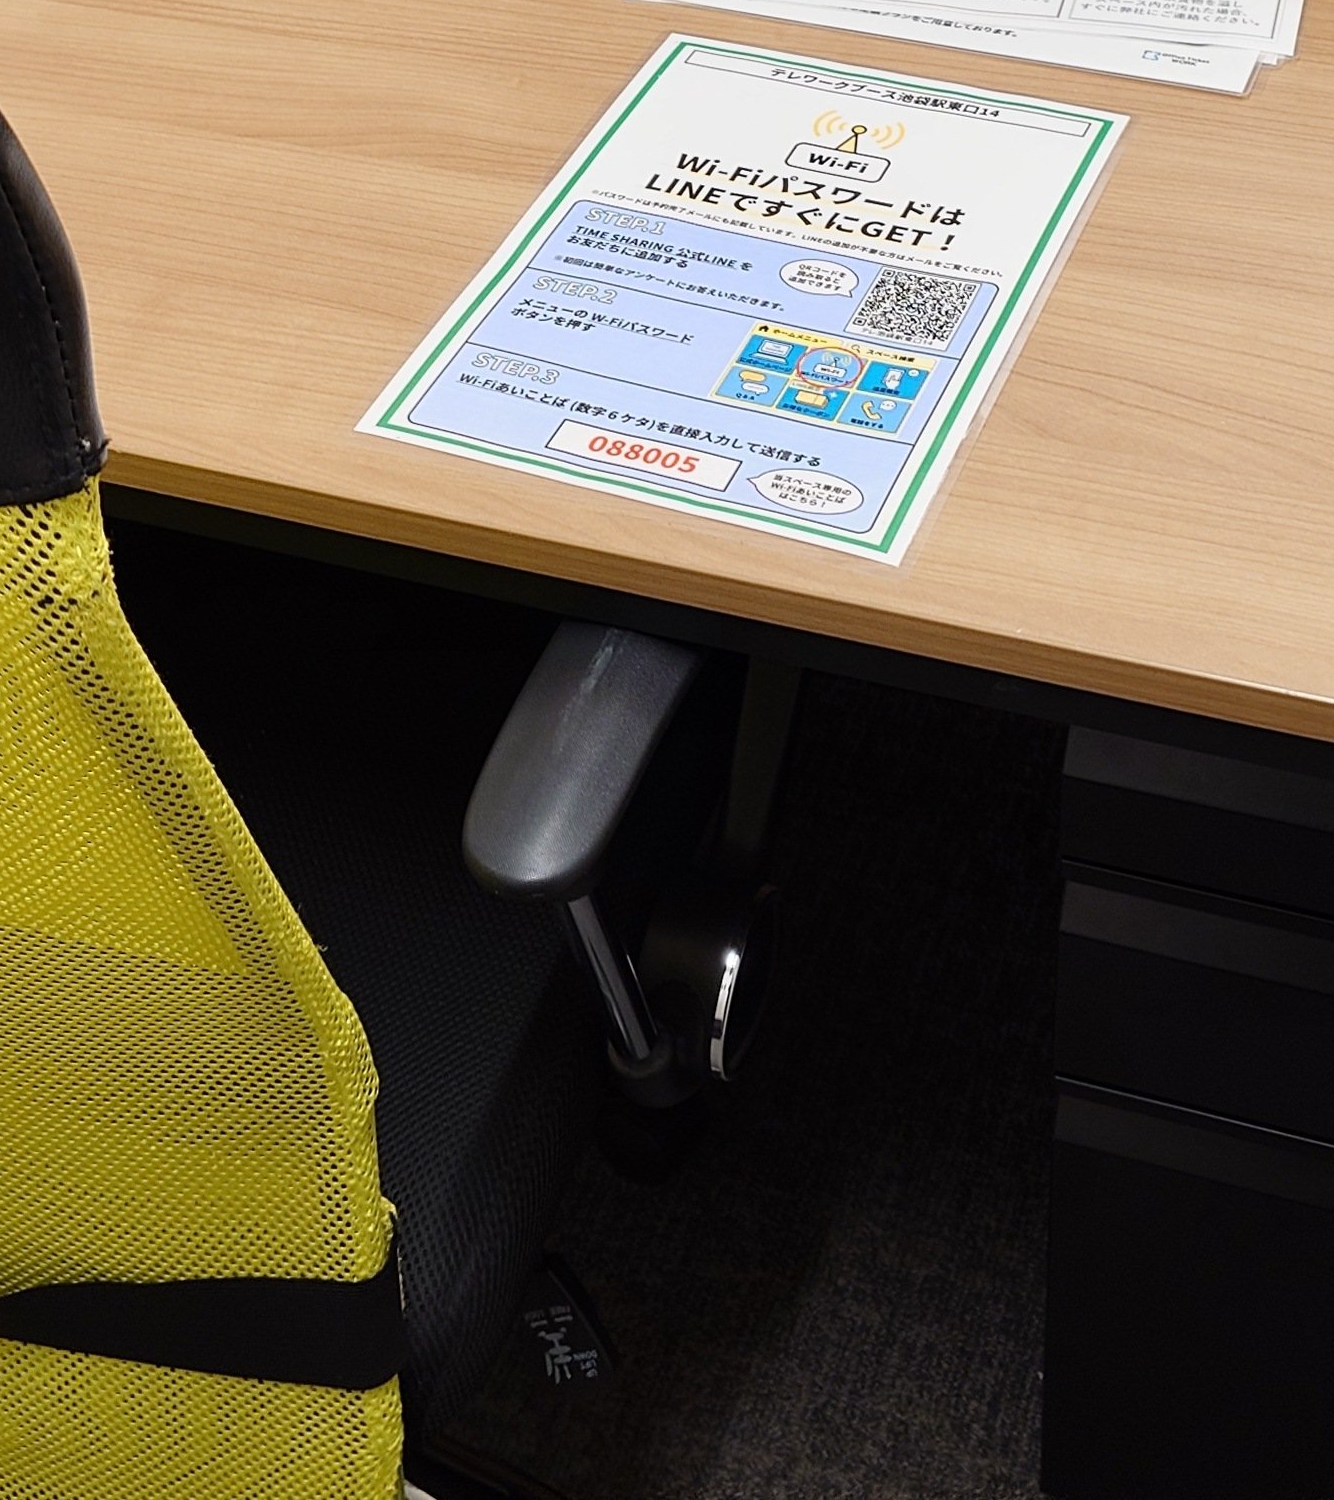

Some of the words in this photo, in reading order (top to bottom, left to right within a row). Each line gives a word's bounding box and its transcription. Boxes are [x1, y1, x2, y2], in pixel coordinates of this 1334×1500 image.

[771, 68, 1001, 119] テレワークブース池袋駅東口14
[808, 152, 870, 175] Wi-Fi
[676, 152, 966, 227] Wi-Fiパスワードは
[584, 208, 667, 236] STEP.1
[645, 173, 957, 252] LINEですぐにGET！
[566, 234, 689, 270] お友だちに追加する
[575, 224, 610, 241] TIME
[610, 231, 675, 254] SHARING
[676, 245, 737, 269] 公式LINE
[739, 261, 753, 271] を
[798, 263, 847, 279] QRコードを
[532, 274, 618, 305] STEP.2
[510, 307, 596, 332] ボタンを押す
[518, 297, 588, 319] メニューの
[471, 351, 561, 385] STEP.3
[459, 372, 568, 409] Wi-Fiあいことば
[587, 435, 700, 474] 088005
[770, 480, 846, 505] Wi-Fiあいことば
[772, 473, 852, 496] 当スペース専用の
